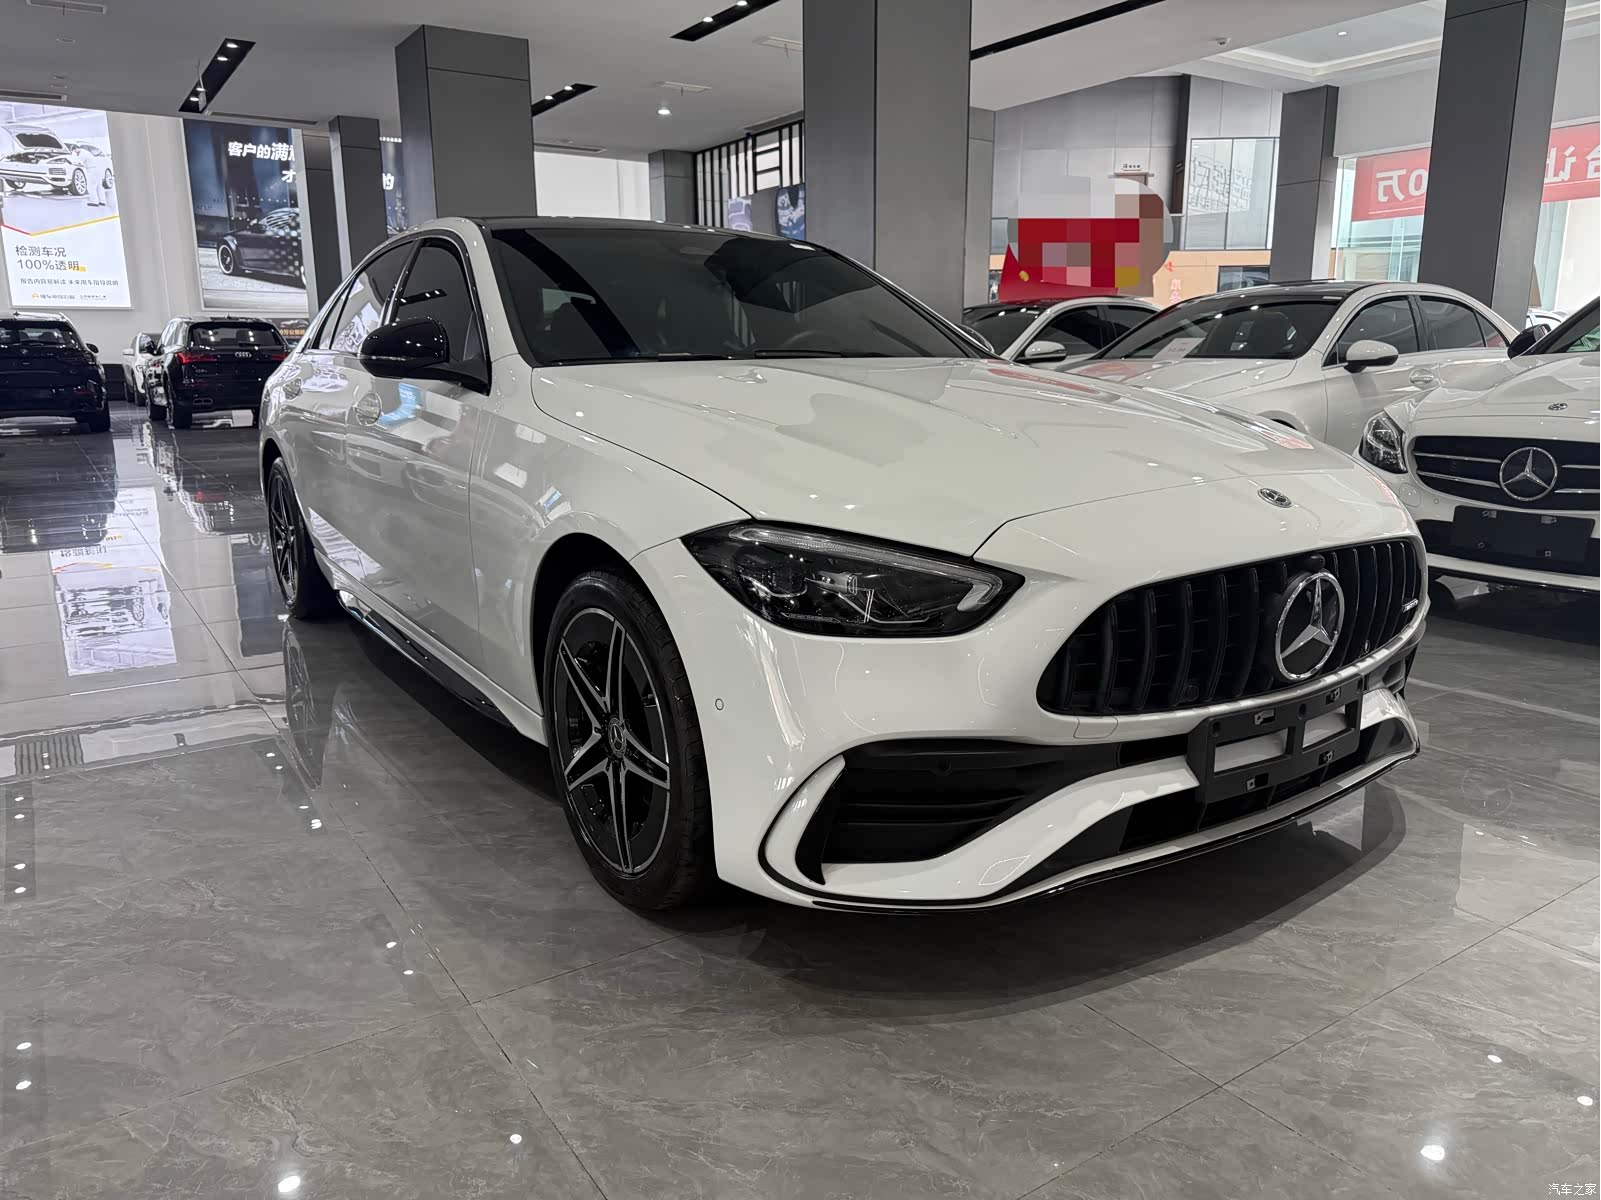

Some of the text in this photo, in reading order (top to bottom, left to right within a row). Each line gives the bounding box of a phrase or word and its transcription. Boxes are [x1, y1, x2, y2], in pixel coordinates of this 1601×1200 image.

[16, 245, 67, 257] 检测车况
[16, 259, 80, 271] 100%透明
